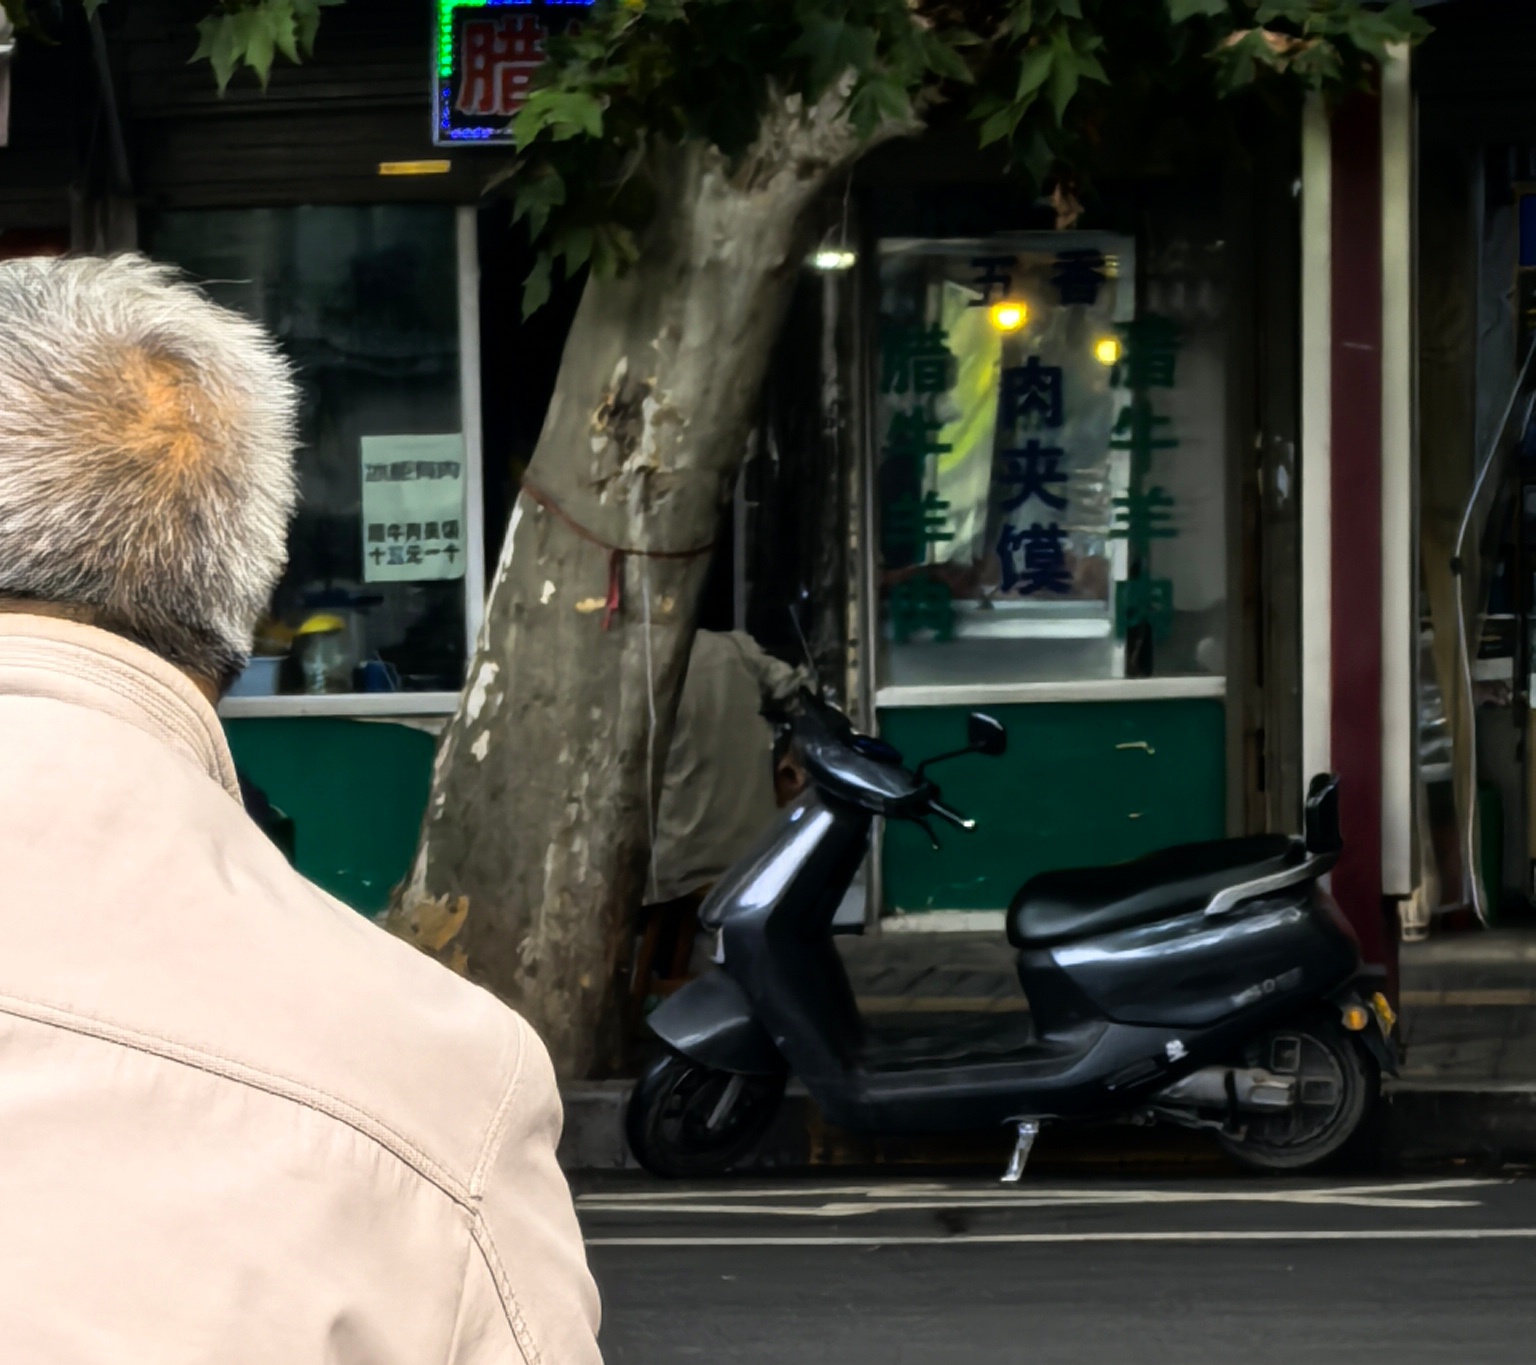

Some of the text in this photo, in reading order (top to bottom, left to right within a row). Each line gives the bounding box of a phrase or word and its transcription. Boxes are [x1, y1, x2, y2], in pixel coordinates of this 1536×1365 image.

[455, 13, 611, 117] 腊
[968, 249, 1106, 307] 五香
[996, 355, 1073, 596] 肉夹馍
